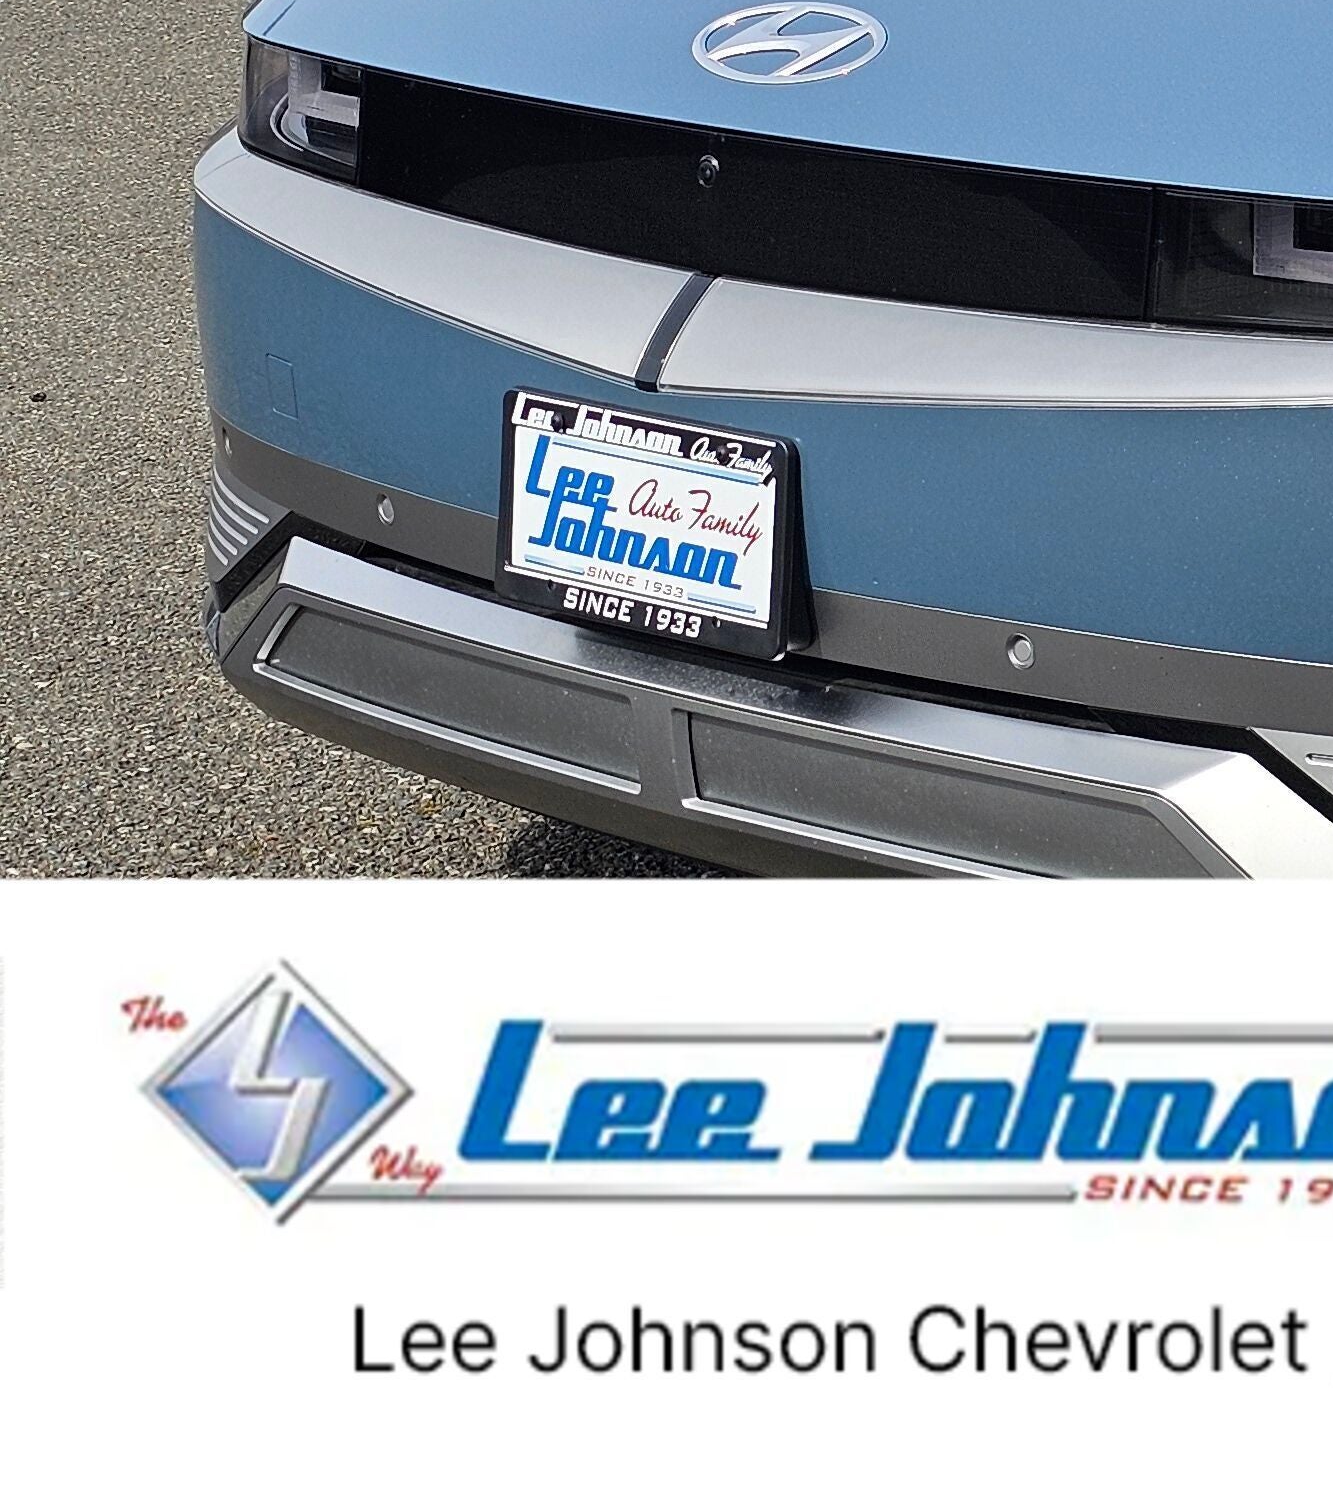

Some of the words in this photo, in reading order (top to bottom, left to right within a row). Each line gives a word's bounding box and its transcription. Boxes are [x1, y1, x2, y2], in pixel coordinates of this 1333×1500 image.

[566, 404, 686, 458] Johnson
[725, 441, 773, 484] Family
[525, 434, 618, 512] Lee
[628, 478, 684, 523] Auto
[688, 489, 763, 556] Family
[528, 496, 742, 591] Johnson
[586, 566, 636, 588] SINCE
[644, 579, 685, 598] 1933
[563, 586, 635, 622] SINCE
[644, 605, 703, 638] 1933
